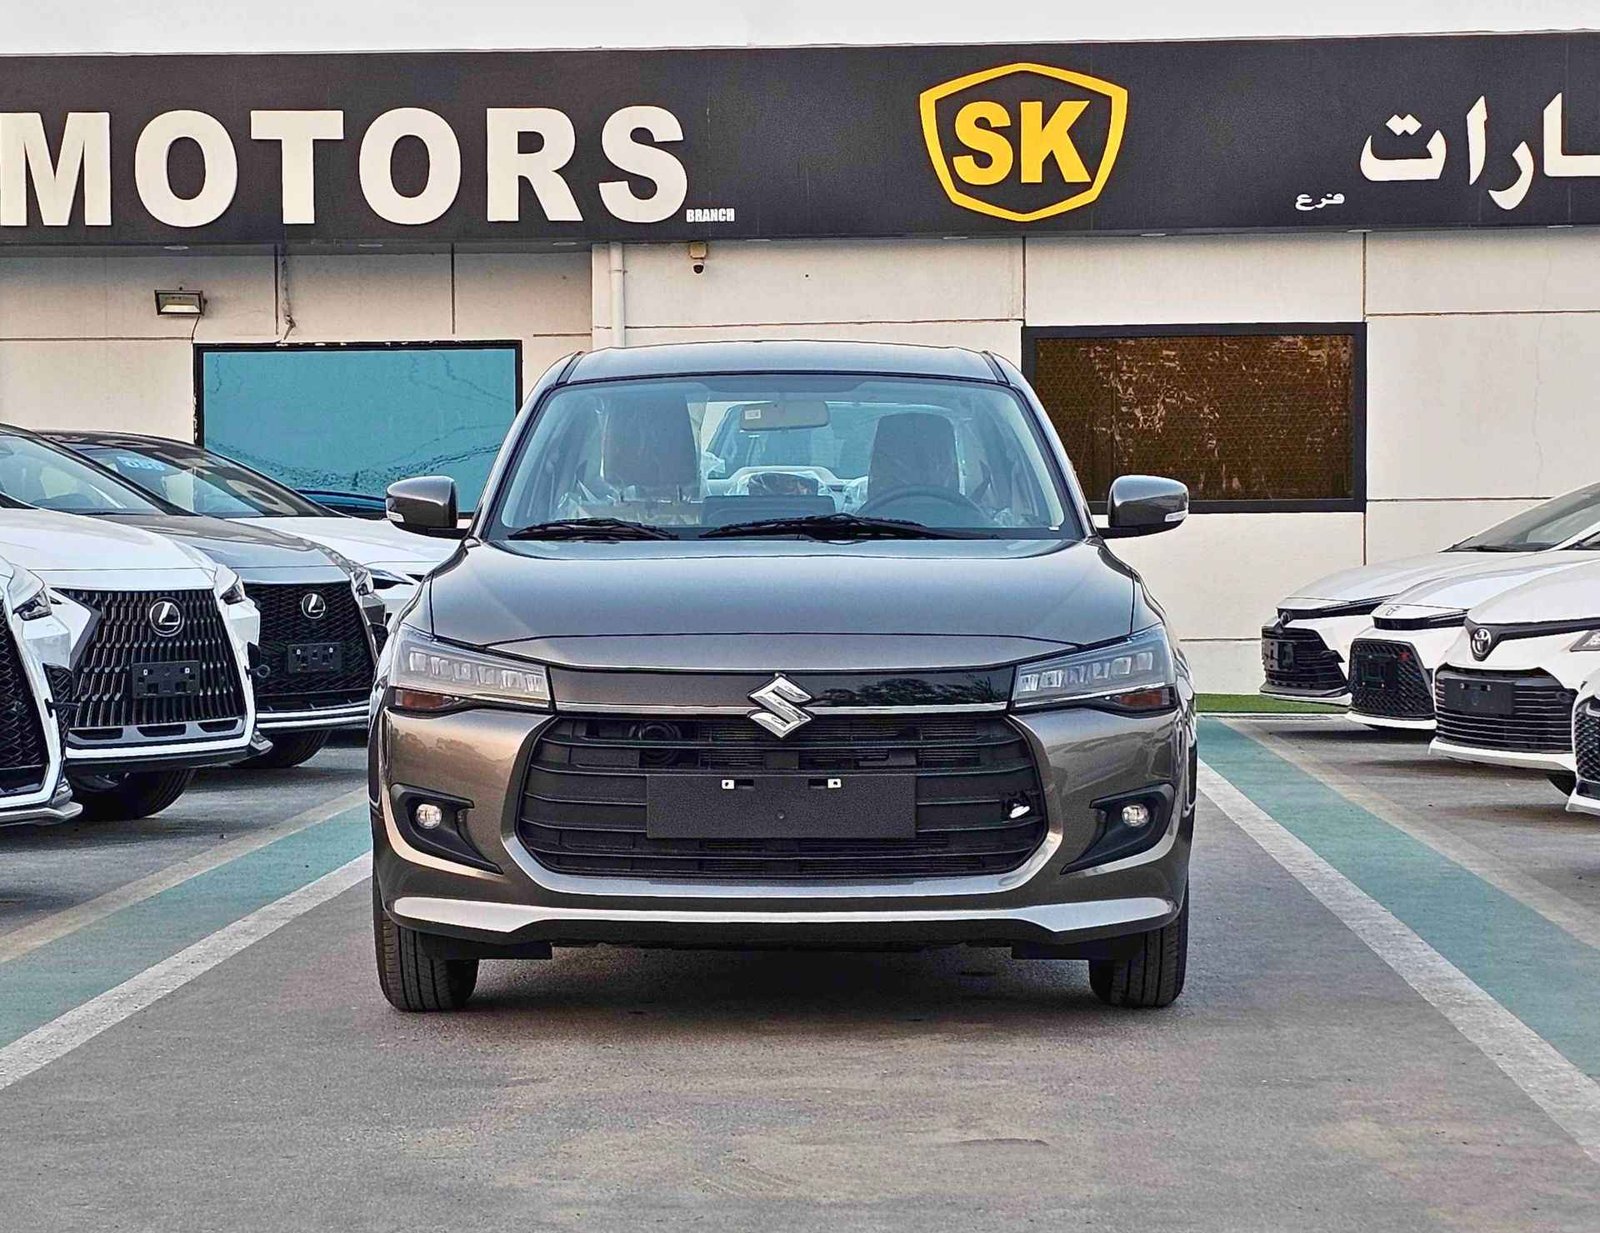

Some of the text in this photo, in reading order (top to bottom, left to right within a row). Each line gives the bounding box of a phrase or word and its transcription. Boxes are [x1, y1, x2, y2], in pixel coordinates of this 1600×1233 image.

[0, 105, 688, 227] MOTORS
[952, 100, 1092, 187] SK
[1360, 93, 1600, 210] ارات
[686, 208, 735, 222] BRANCH
[1295, 192, 1345, 211] فرع
